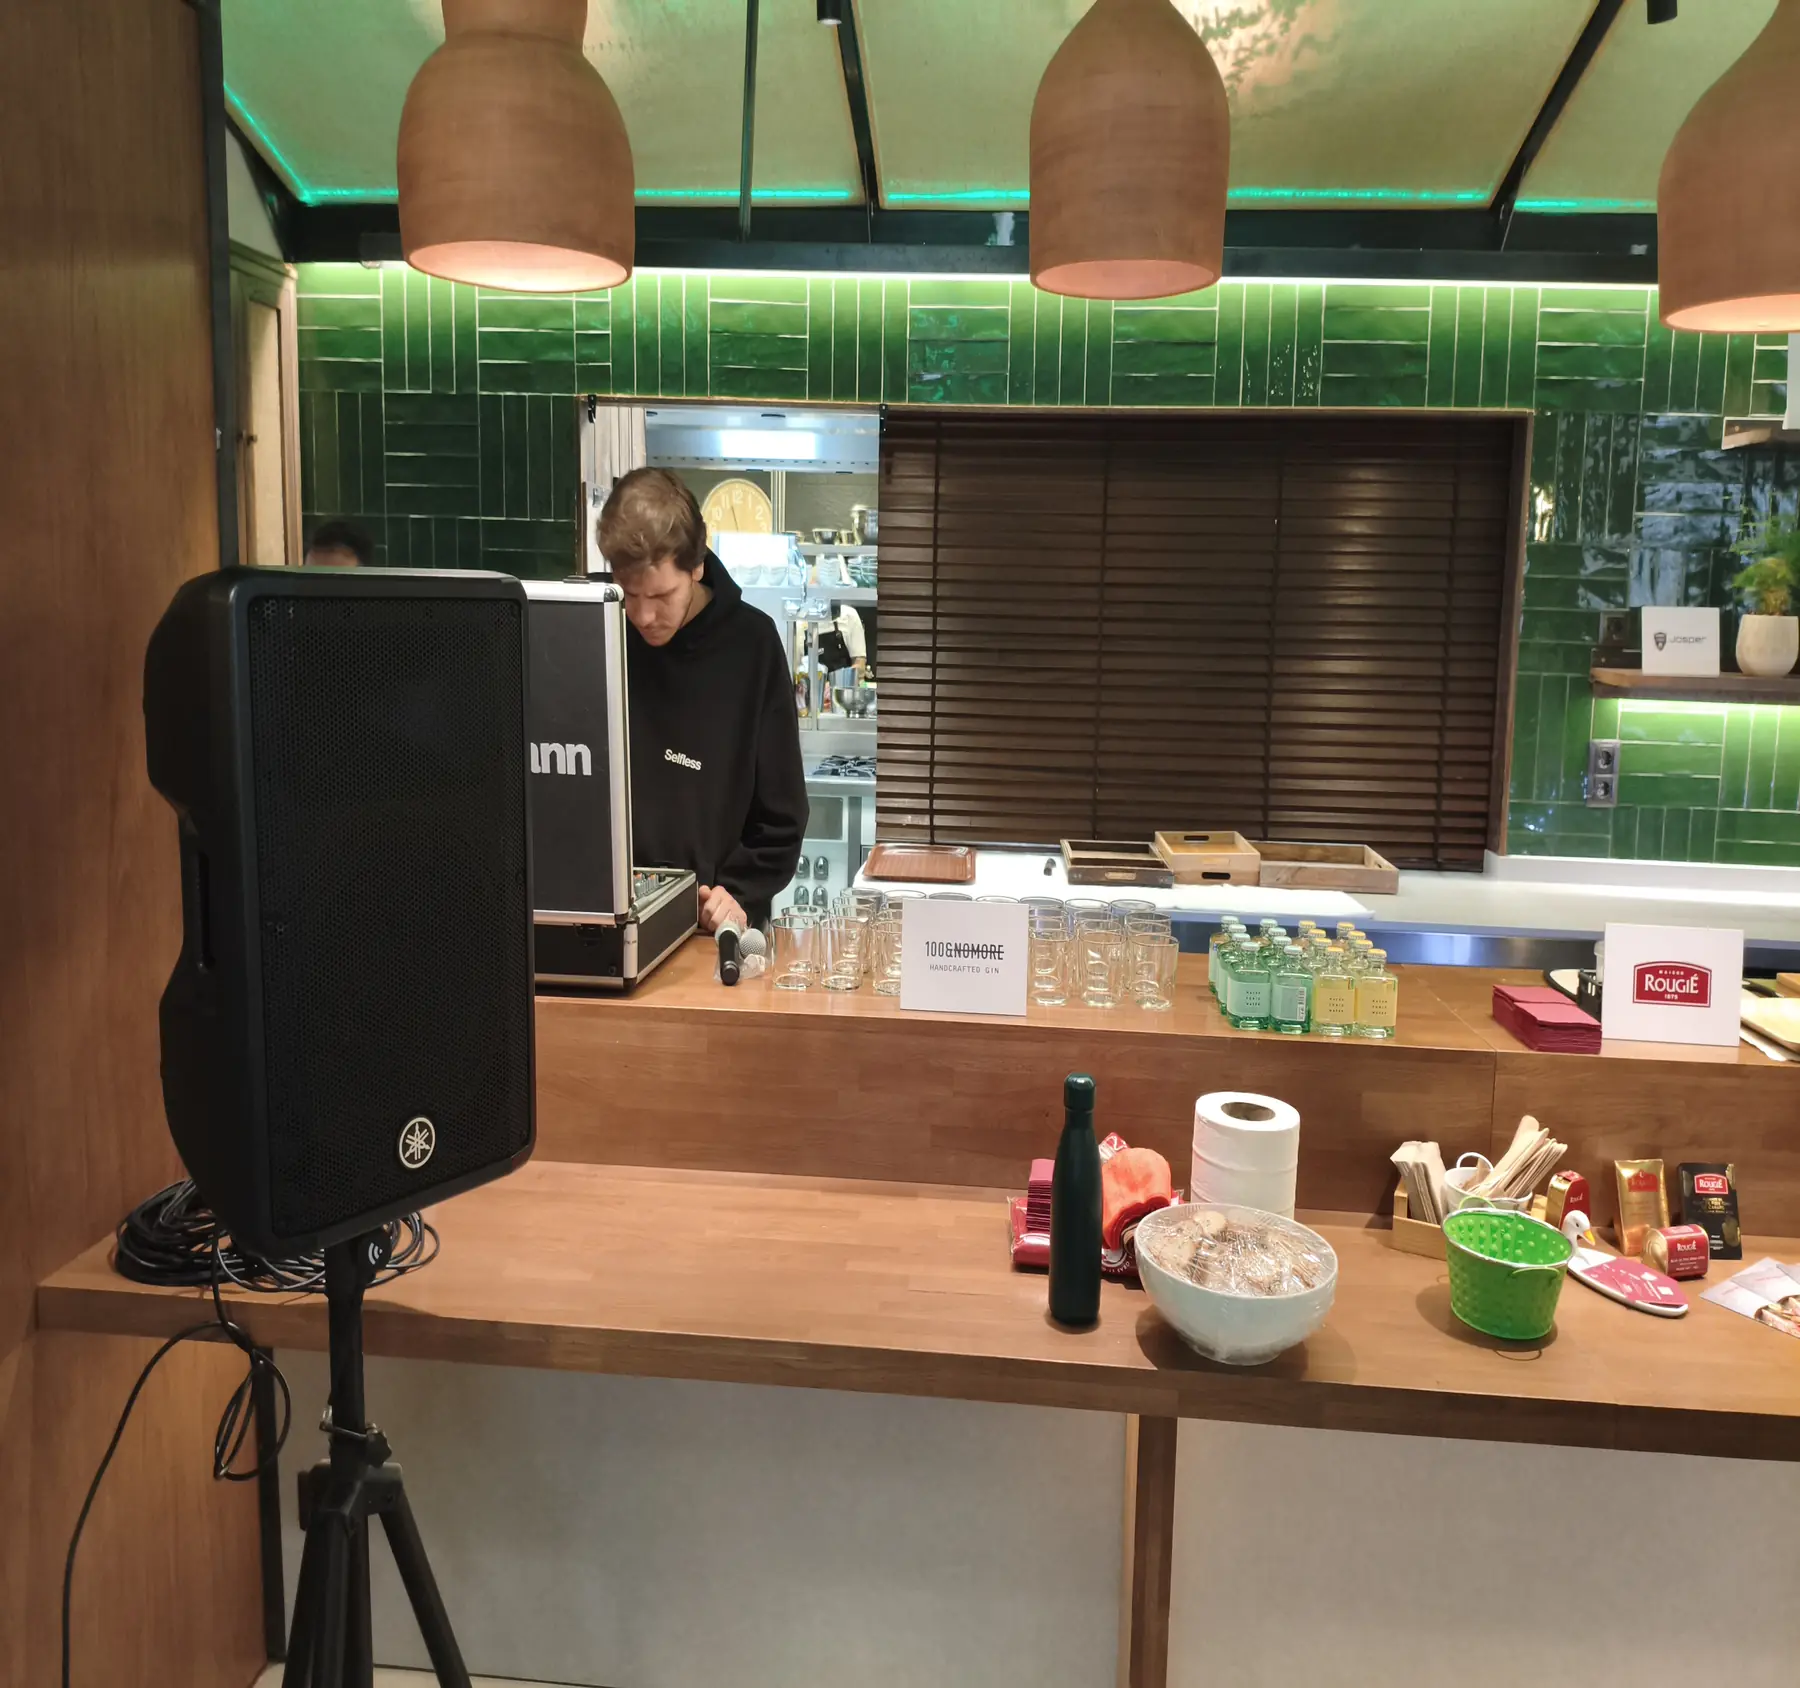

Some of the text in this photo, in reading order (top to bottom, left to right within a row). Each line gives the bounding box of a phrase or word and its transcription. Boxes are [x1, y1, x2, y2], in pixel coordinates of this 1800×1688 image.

[664, 748, 702, 771] Selfless
[925, 941, 1004, 961] 100&NOMORE
[929, 964, 1000, 975] HANDCRAFTED GIN
[1644, 973, 1699, 994] ROUGIÉ
